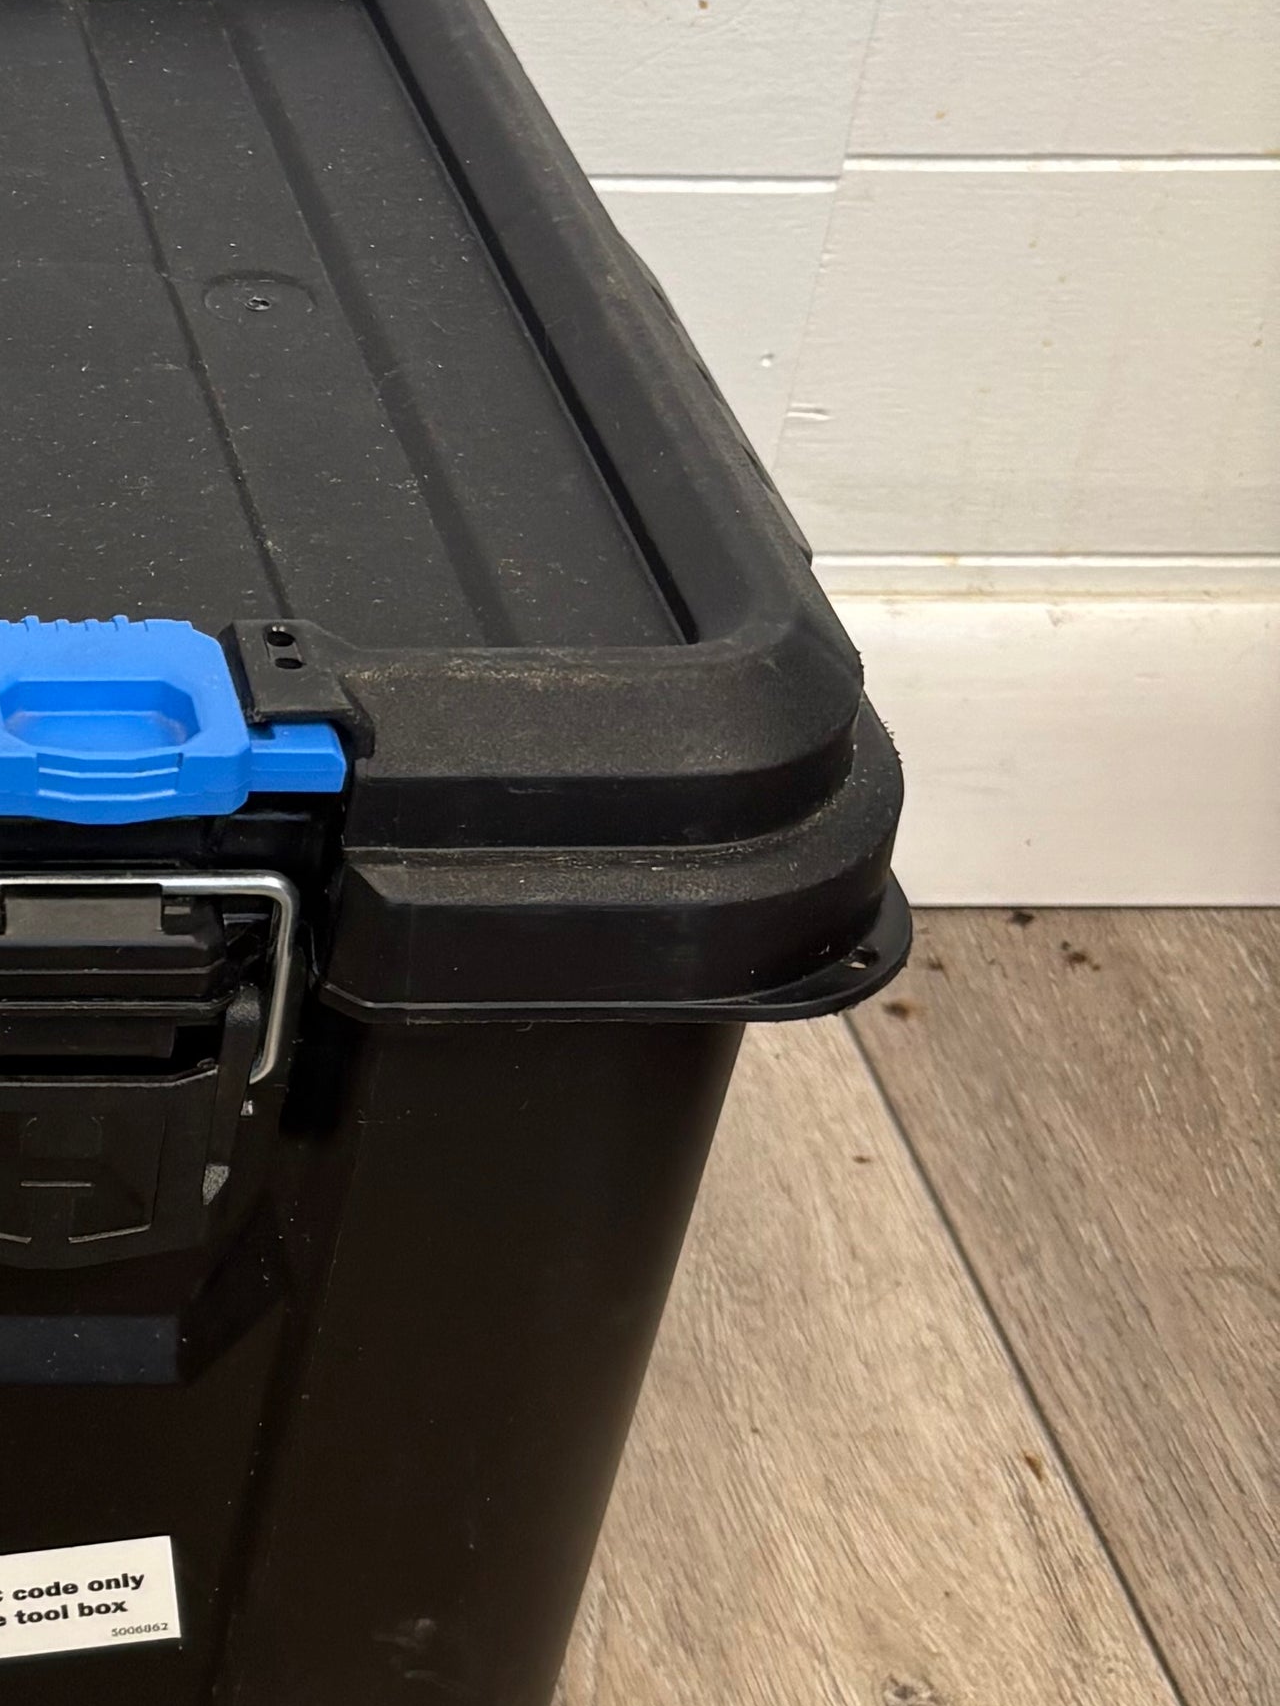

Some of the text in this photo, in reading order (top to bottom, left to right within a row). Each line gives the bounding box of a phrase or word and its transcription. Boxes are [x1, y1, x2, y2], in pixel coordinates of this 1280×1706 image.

[12, 1582, 79, 1601] code
[88, 1573, 145, 1592] only
[14, 1604, 69, 1624] tool
[78, 1599, 128, 1618] box
